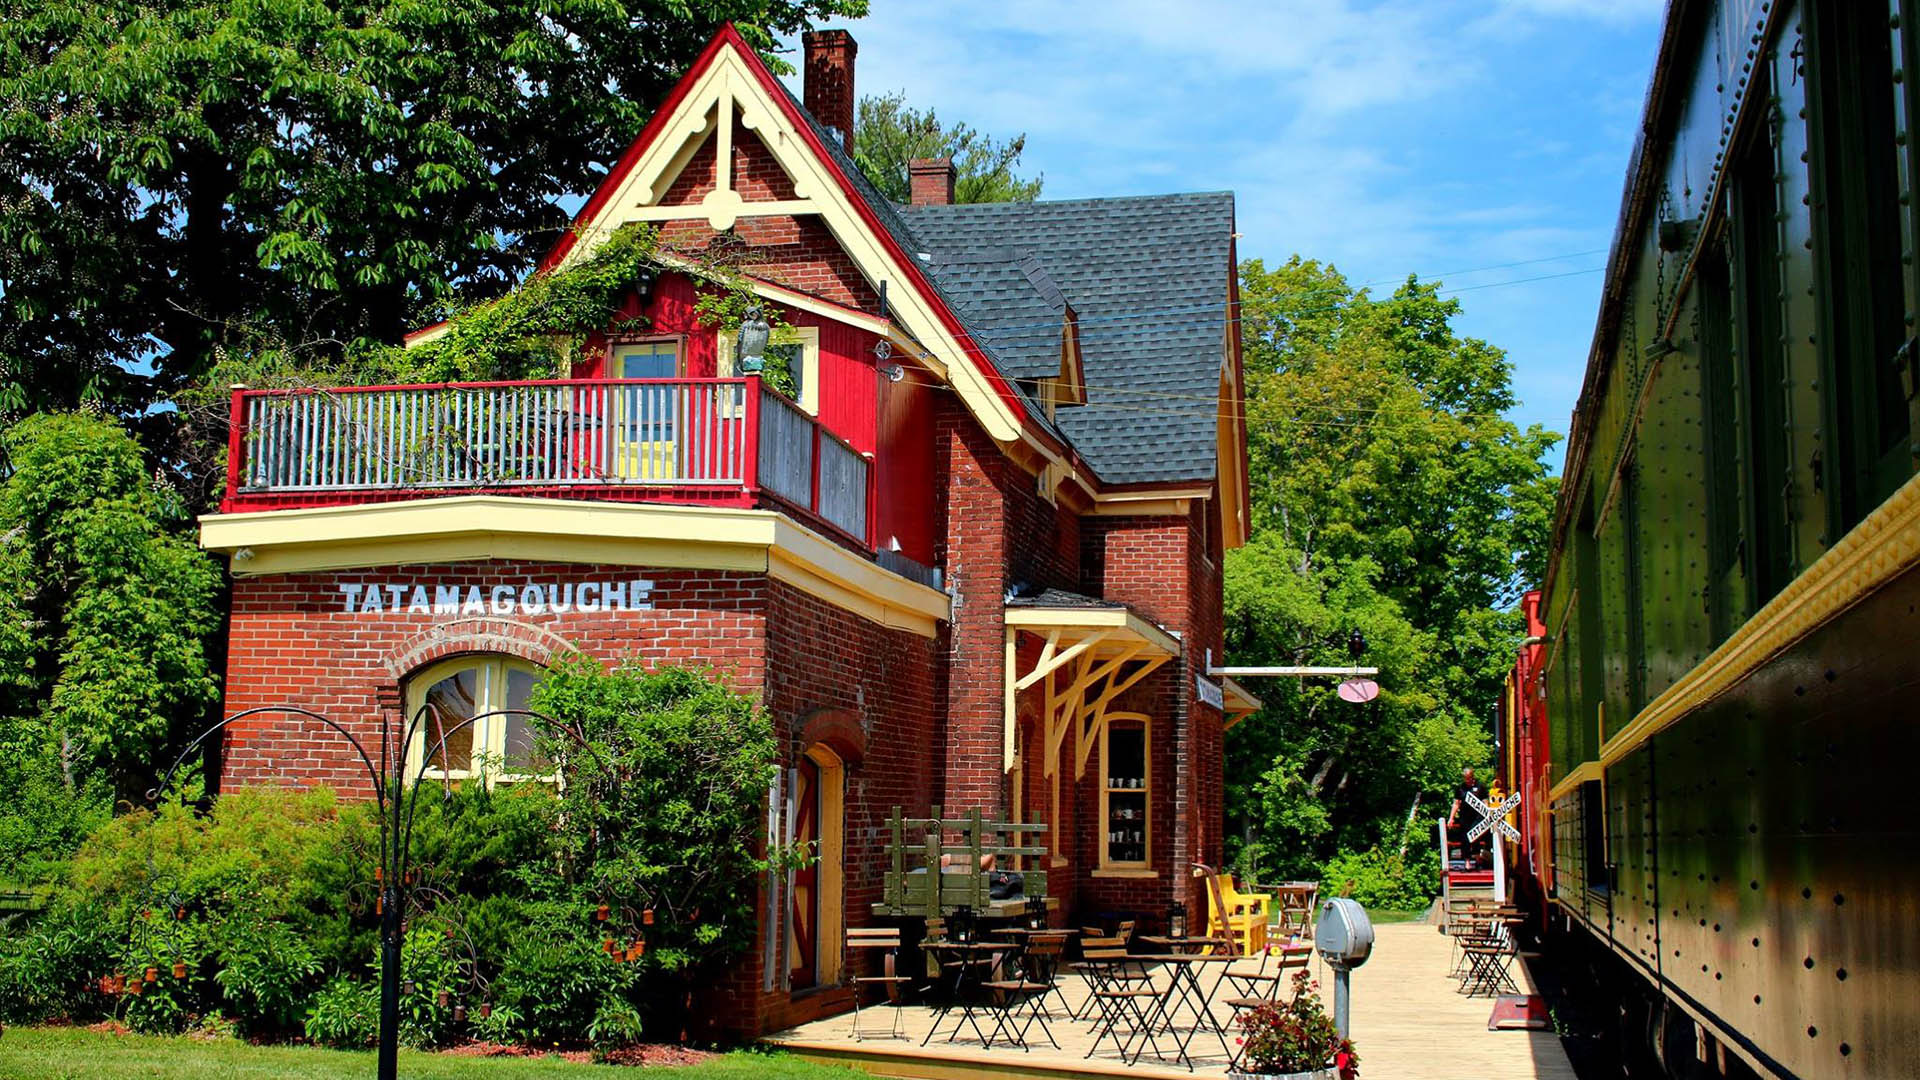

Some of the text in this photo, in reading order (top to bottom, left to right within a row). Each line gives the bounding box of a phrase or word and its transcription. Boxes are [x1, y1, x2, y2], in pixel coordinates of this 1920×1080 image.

[339, 579, 655, 615] TATAMAGOUCHE
[1466, 793, 1489, 817] TRAIN
[1468, 793, 1519, 839] TATAMAGOUCHE
